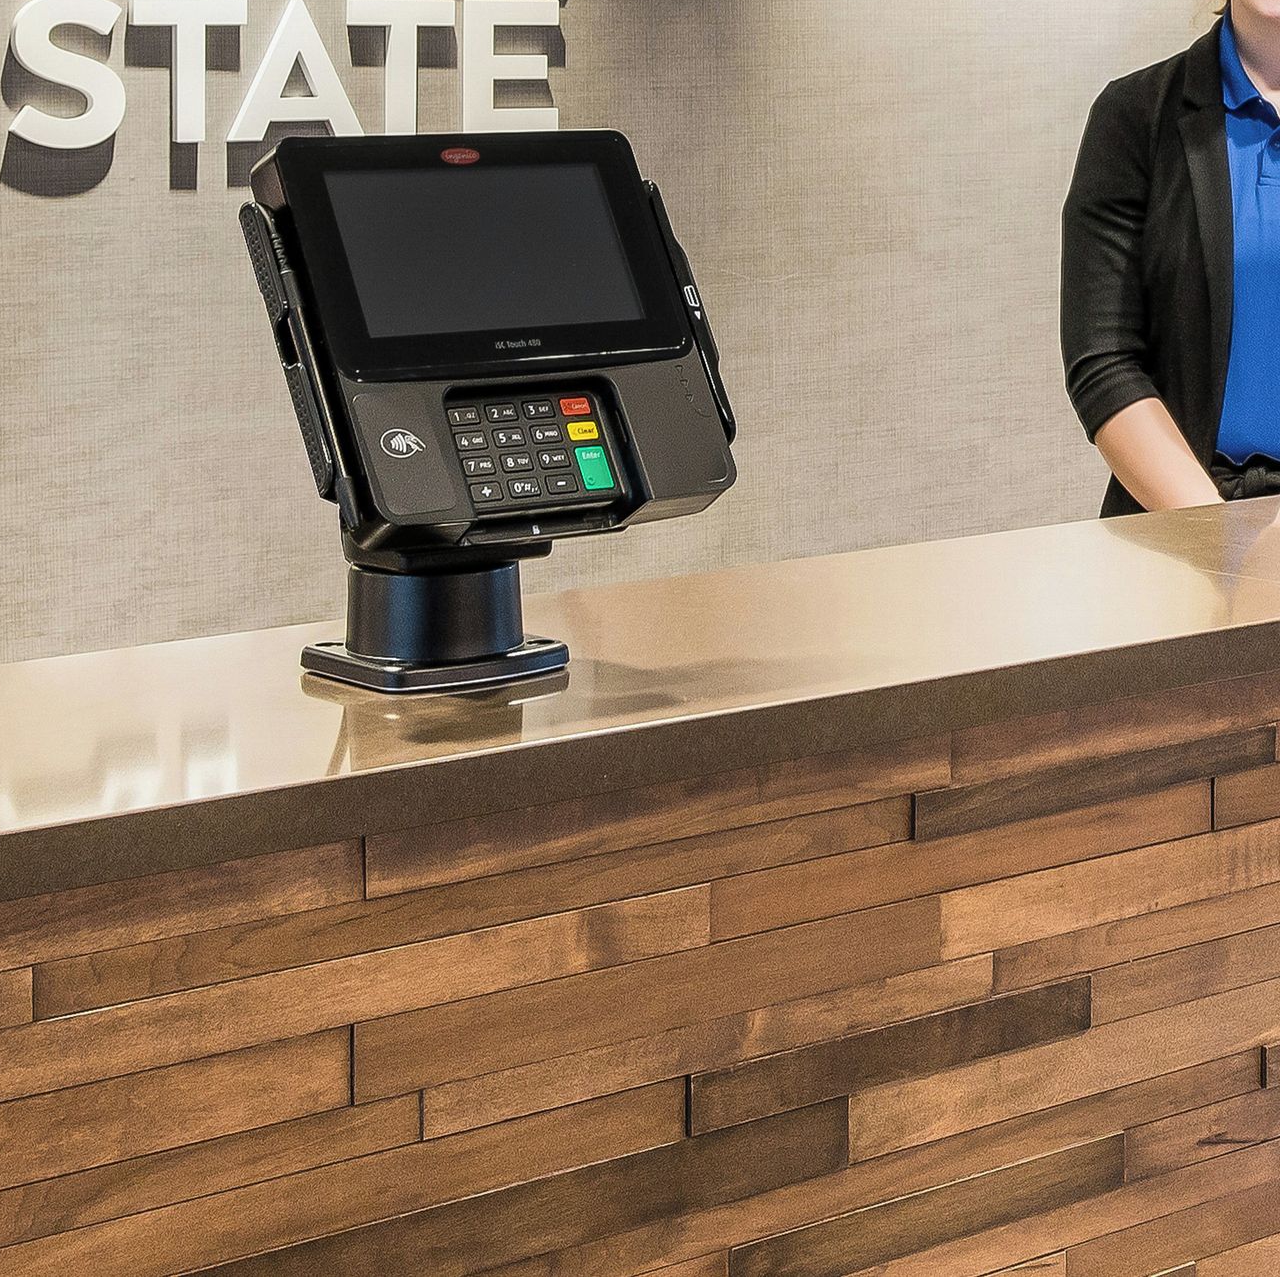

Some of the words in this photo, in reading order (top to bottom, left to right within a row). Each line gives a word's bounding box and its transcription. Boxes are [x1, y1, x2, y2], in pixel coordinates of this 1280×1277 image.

[491, 408, 499, 418] 2
[528, 405, 535, 415] 3
[498, 433, 507, 443] 5
[535, 429, 544, 440] 6
[461, 436, 469, 447] 4
[542, 453, 550, 464] 9
[581, 451, 601, 460] Enter
[467, 461, 475, 472] 7
[506, 457, 515, 468] 8
